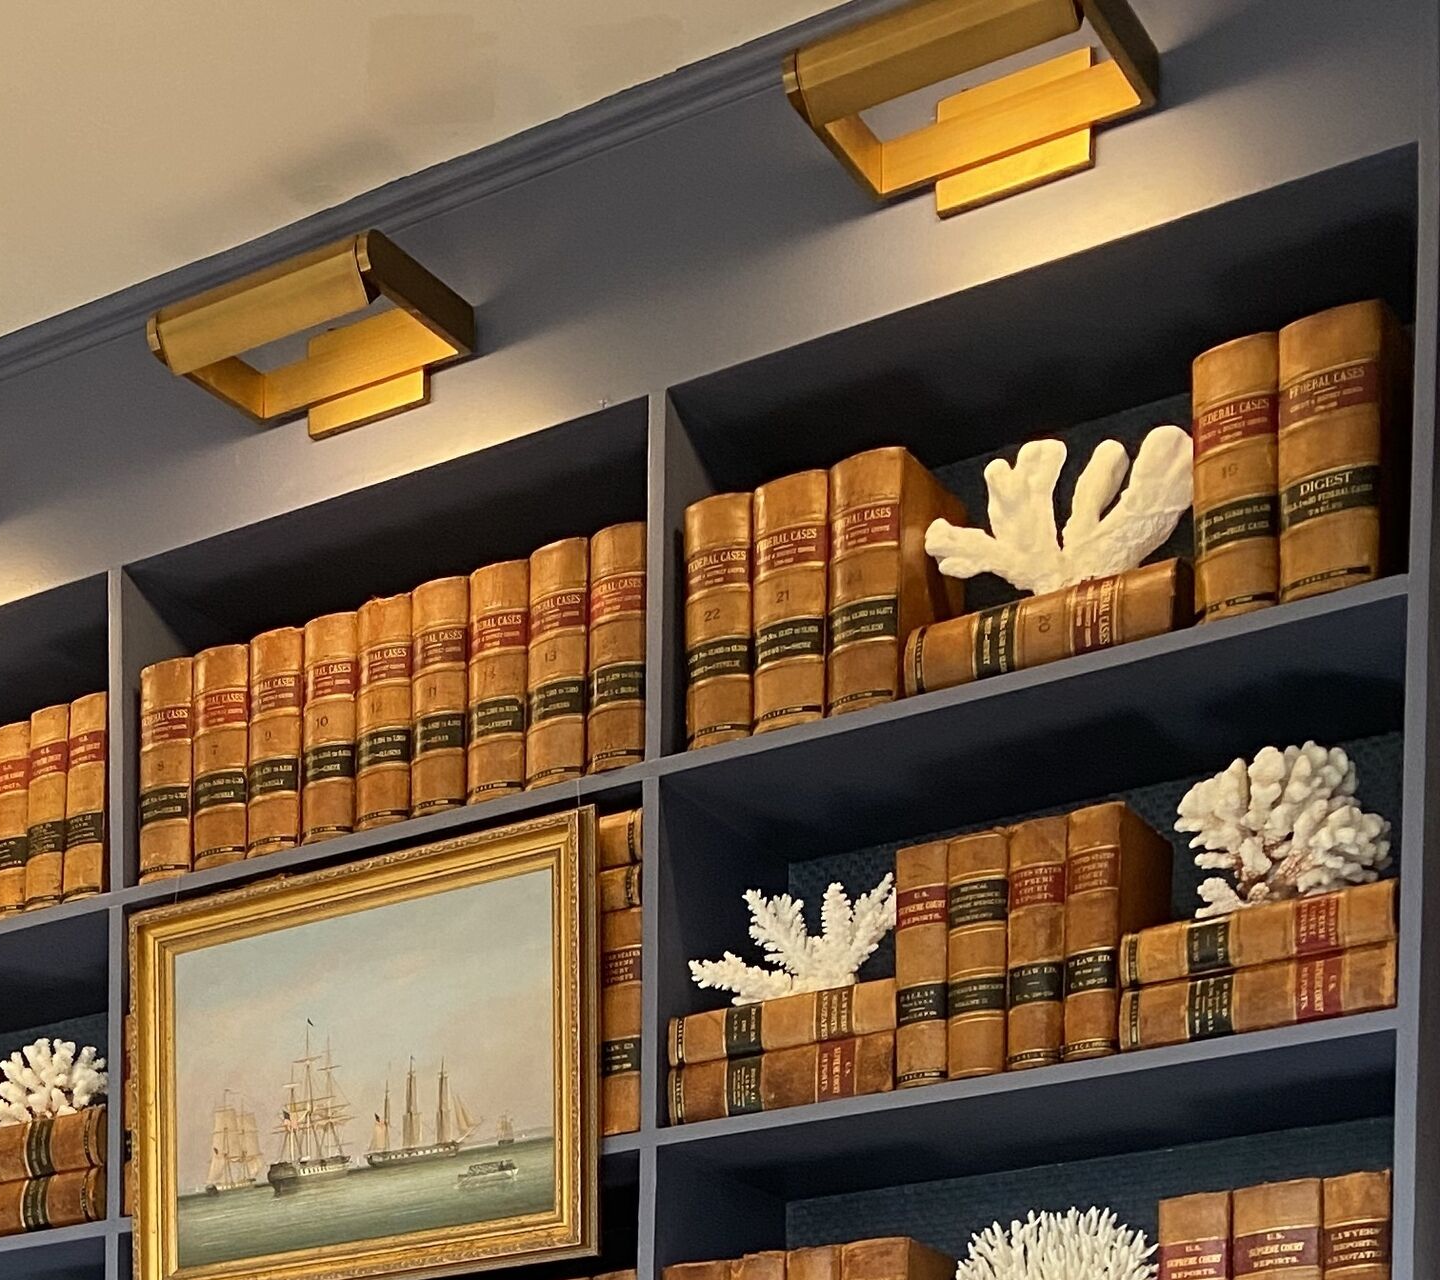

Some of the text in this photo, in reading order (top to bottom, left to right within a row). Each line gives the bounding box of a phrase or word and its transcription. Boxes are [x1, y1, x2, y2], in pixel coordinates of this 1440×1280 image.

[1334, 366, 1366, 383] CASES
[1199, 406, 1236, 428] FEDERAL
[1239, 398, 1271, 414] CASES
[1300, 471, 1353, 497] DIGEST
[864, 506, 892, 521] CASES
[756, 532, 789, 553] FEDERAL
[791, 528, 817, 542] CASES
[688, 554, 719, 574] FEDERAL
[720, 550, 746, 563] CASES
[618, 577, 642, 590] CASES
[556, 593, 581, 605] CASES
[776, 591, 790, 604] 21
[498, 614, 522, 626] CASES
[703, 608, 720, 623] 22
[1038, 614, 1050, 634] 20
[439, 630, 463, 642] CASES
[383, 647, 407, 658] CASES
[544, 650, 556, 662] 13
[328, 663, 351, 674] CASES
[273, 677, 295, 688] CASES
[222, 692, 244, 703] CASES
[166, 708, 189, 719] CASES
[315, 716, 328, 728] 10
[1019, 885, 1048, 895] COURT
[1267, 1232, 1285, 1241] U.S.
[1185, 1244, 1203, 1252] U.S.
[1280, 1241, 1305, 1252] COURT
[1199, 1253, 1222, 1264] COURT
[1253, 1256, 1300, 1268] REPORTS.
[1171, 1268, 1217, 1280] REPORTS.
